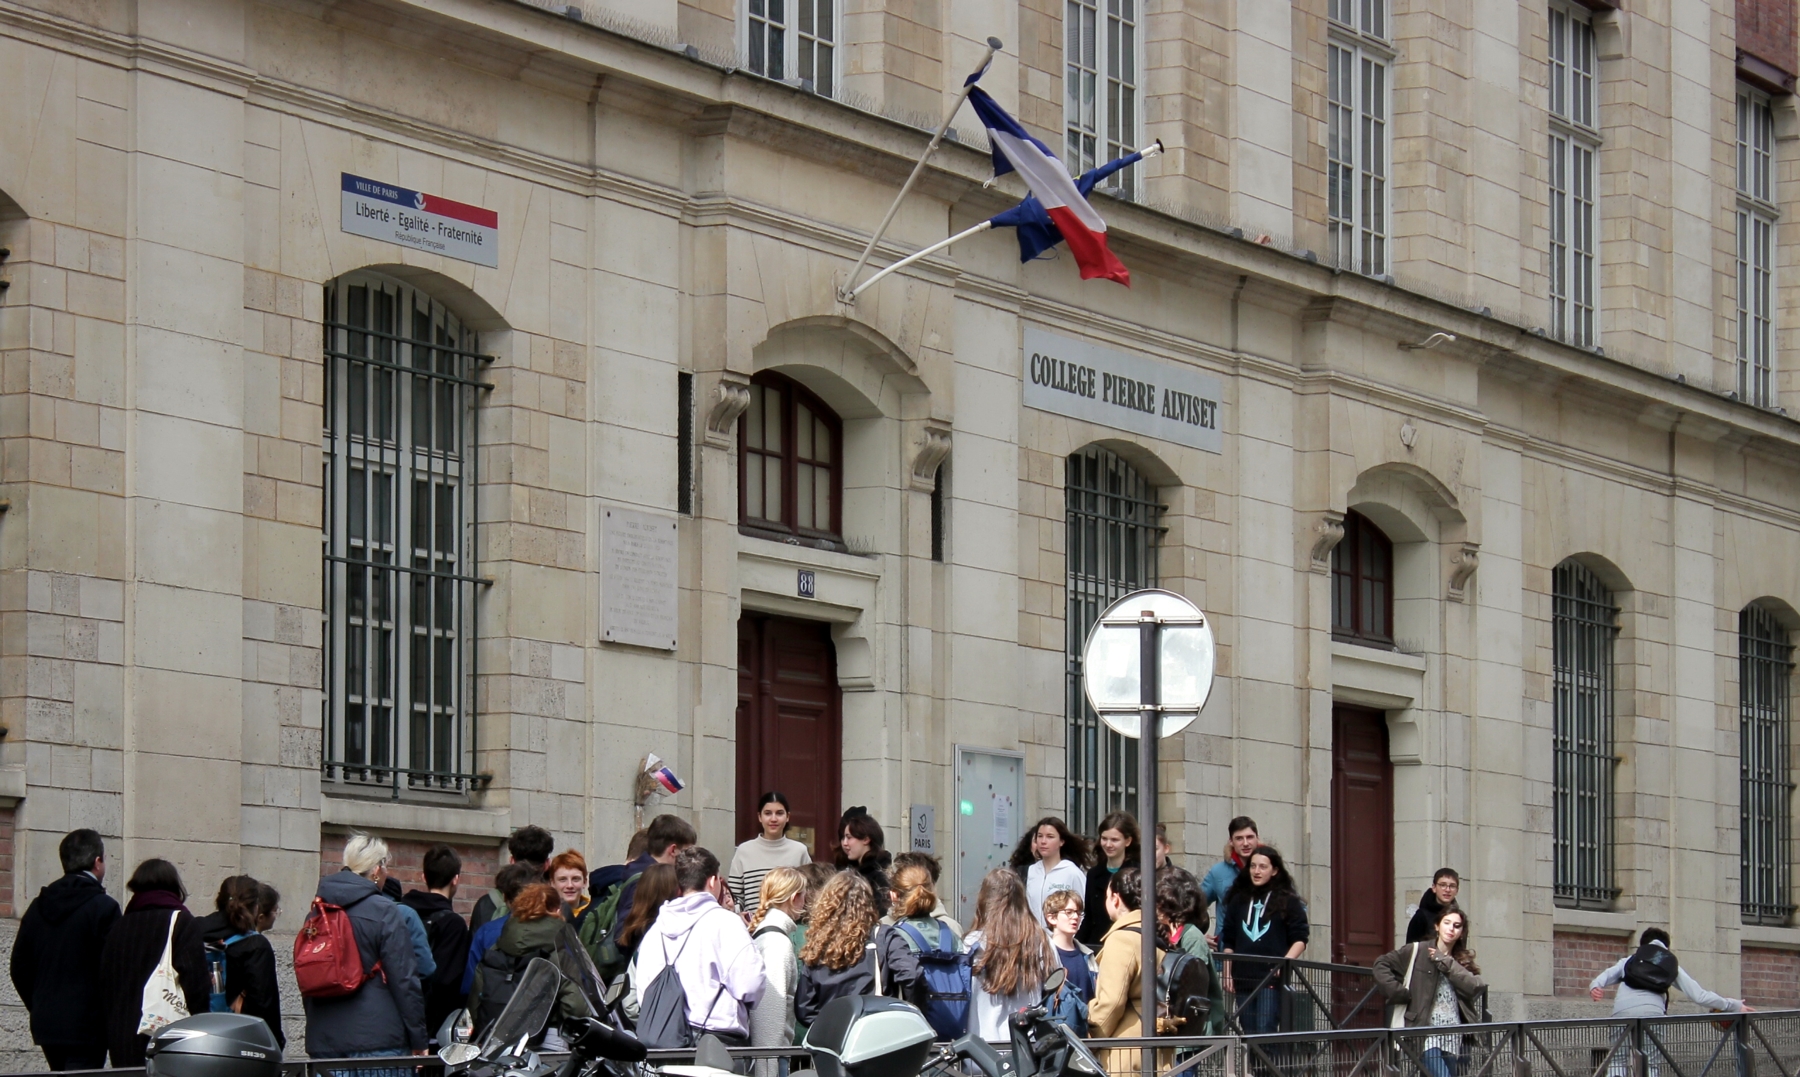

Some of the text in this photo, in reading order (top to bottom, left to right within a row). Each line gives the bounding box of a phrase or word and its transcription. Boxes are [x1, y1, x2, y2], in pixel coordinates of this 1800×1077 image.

[355, 181, 398, 199] VILLE DE PARIS
[356, 201, 390, 223] Liberté
[398, 212, 429, 232] Egalité
[438, 222, 483, 246] Fraternité
[395, 231, 446, 250] République Française
[1030, 353, 1217, 430] COLLEGE PIERRE ALVISET
[800, 573, 814, 594] 88
[914, 838, 931, 849] PARIS
